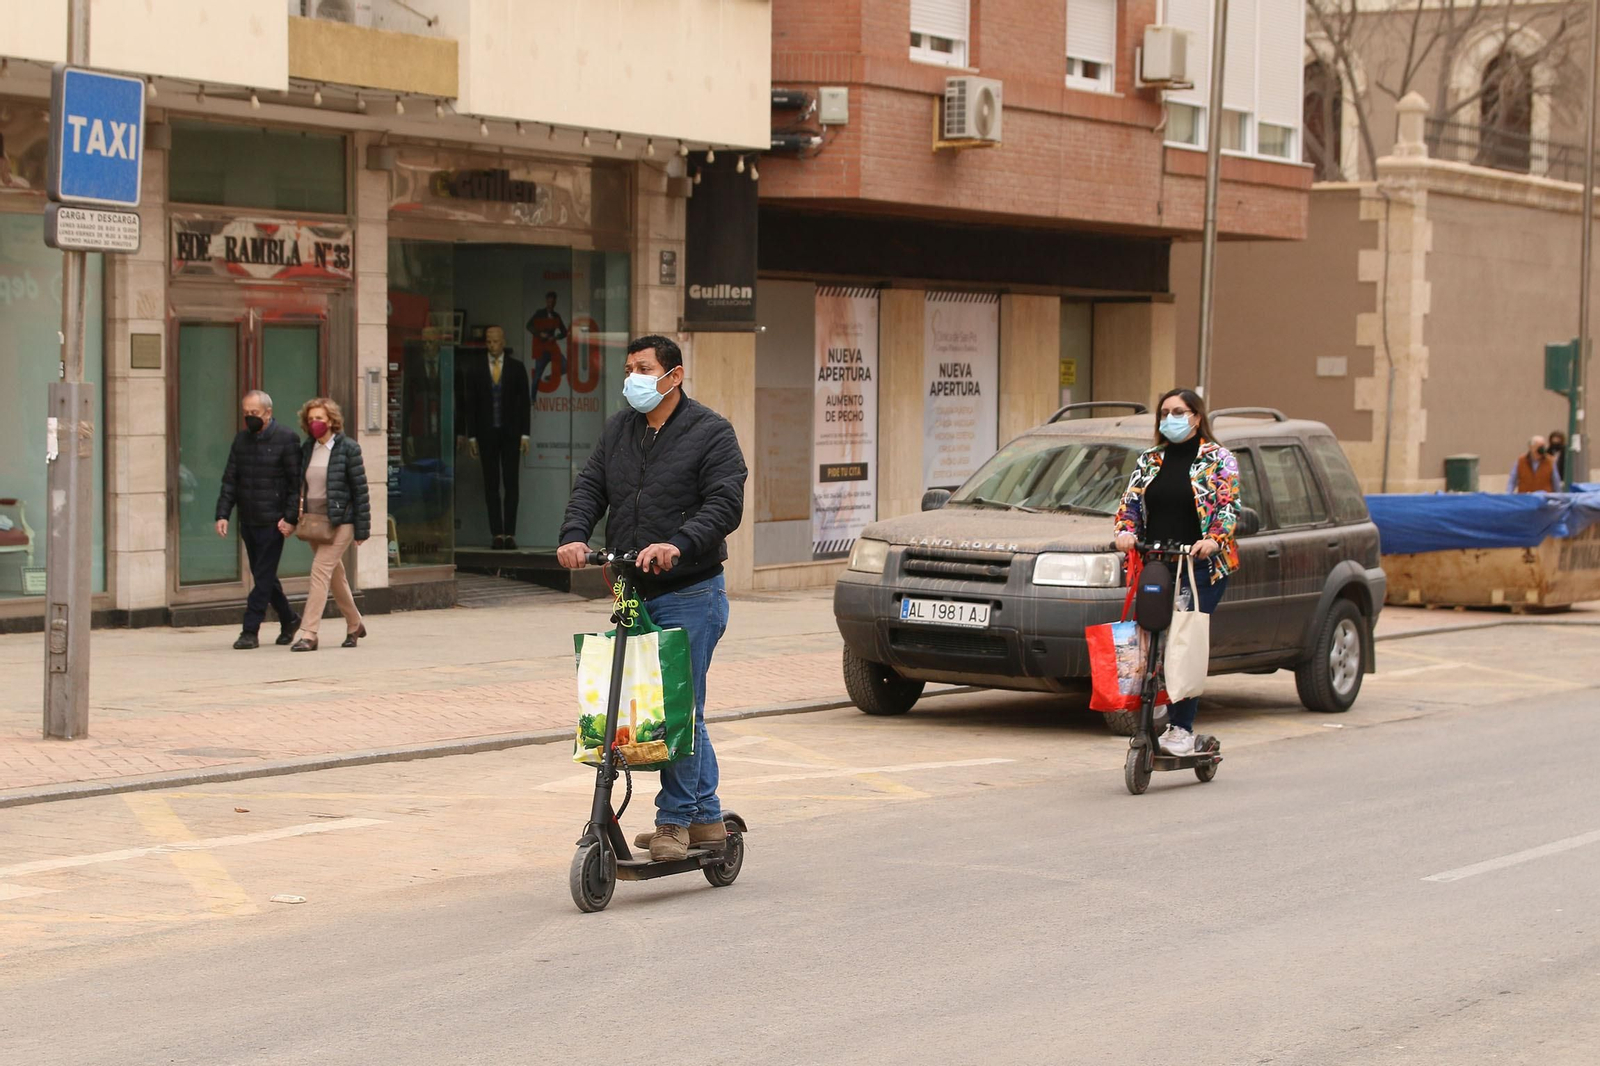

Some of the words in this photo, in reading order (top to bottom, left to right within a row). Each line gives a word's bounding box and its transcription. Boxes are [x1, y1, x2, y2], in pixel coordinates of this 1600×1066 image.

[68, 114, 136, 161] TAXI
[60, 210, 86, 221] CARGA
[90, 213, 94, 221] Y
[97, 213, 137, 225] DESCARGA
[111, 240, 132, 248] MINUTOS
[224, 235, 302, 267] RAMBLA
[333, 243, 350, 269] 33
[689, 284, 753, 299] Guillen
[828, 348, 863, 363] NUEVA
[817, 366, 872, 381] APERTURA
[939, 362, 973, 378] NUEVA
[929, 381, 981, 396] APERTURA
[533, 397, 600, 413] ANIVERSARIO
[826, 394, 864, 406] AUMENTO
[825, 410, 836, 422] DE
[838, 410, 864, 422] PECHO
[827, 467, 840, 477] PIDE
[841, 467, 848, 477] TU
[849, 466, 862, 476] CITA
[909, 537, 953, 547] LAND
[960, 541, 1019, 550] ROVER
[908, 602, 925, 618] AL
[932, 603, 964, 621] 1981
[968, 607, 988, 622] AJ
